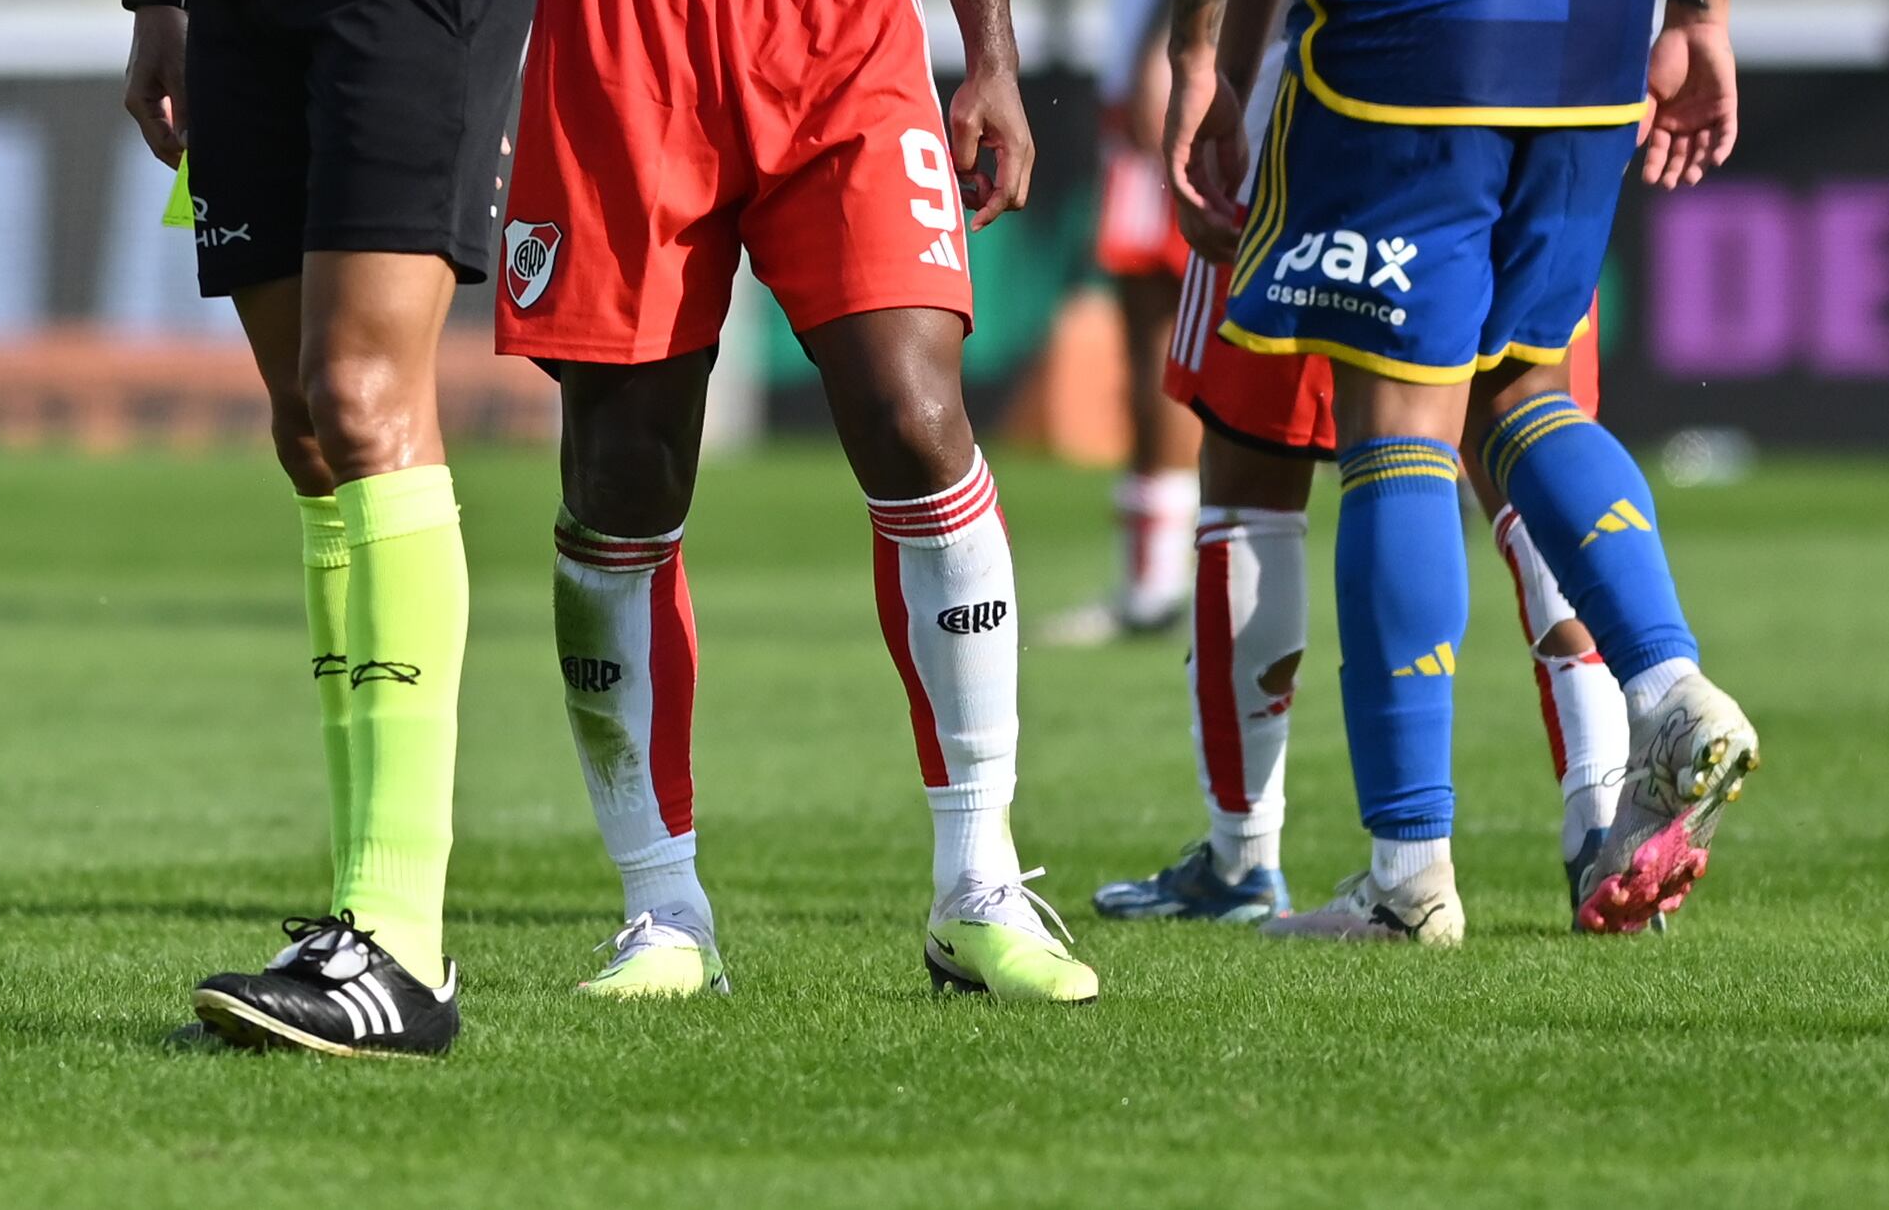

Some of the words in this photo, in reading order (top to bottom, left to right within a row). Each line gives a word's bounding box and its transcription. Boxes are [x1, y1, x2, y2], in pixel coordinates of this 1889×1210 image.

[898, 127, 958, 232] 9
[1273, 229, 1418, 293] pax
[1266, 283, 1407, 326] assistance
